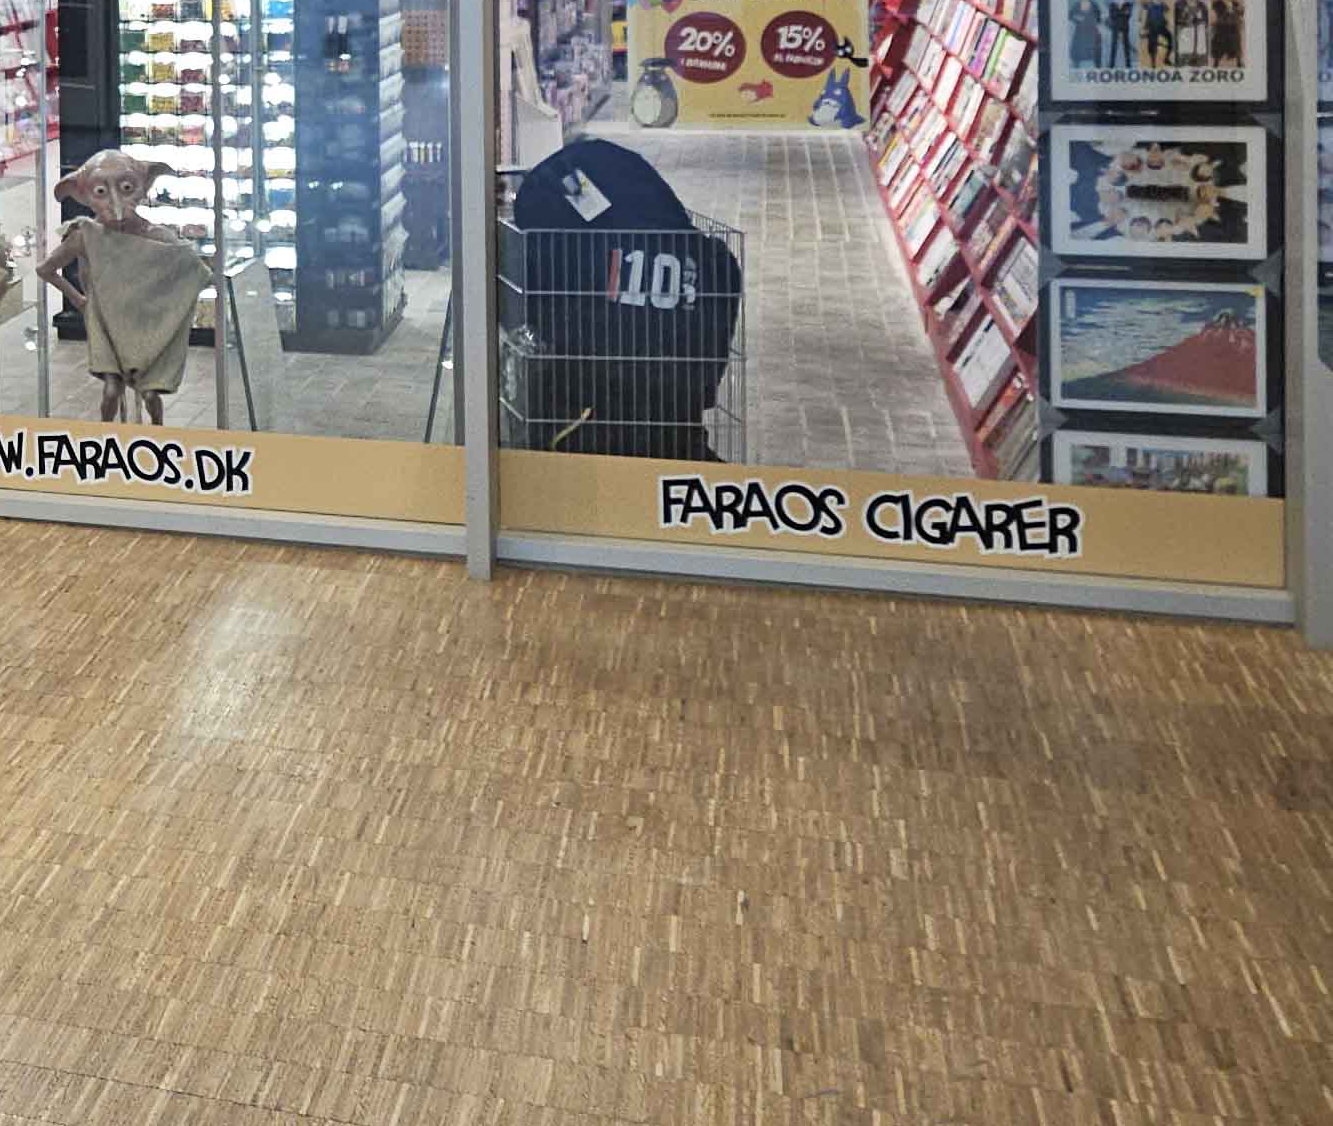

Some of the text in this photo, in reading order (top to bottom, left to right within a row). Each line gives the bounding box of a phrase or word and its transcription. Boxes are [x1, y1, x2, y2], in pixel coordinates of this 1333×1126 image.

[677, 26, 736, 57] 20%
[776, 24, 826, 53] 15%
[1085, 69, 1245, 83] RORONOA ZORO
[662, 478, 1081, 554] FARAOS CIGARER
